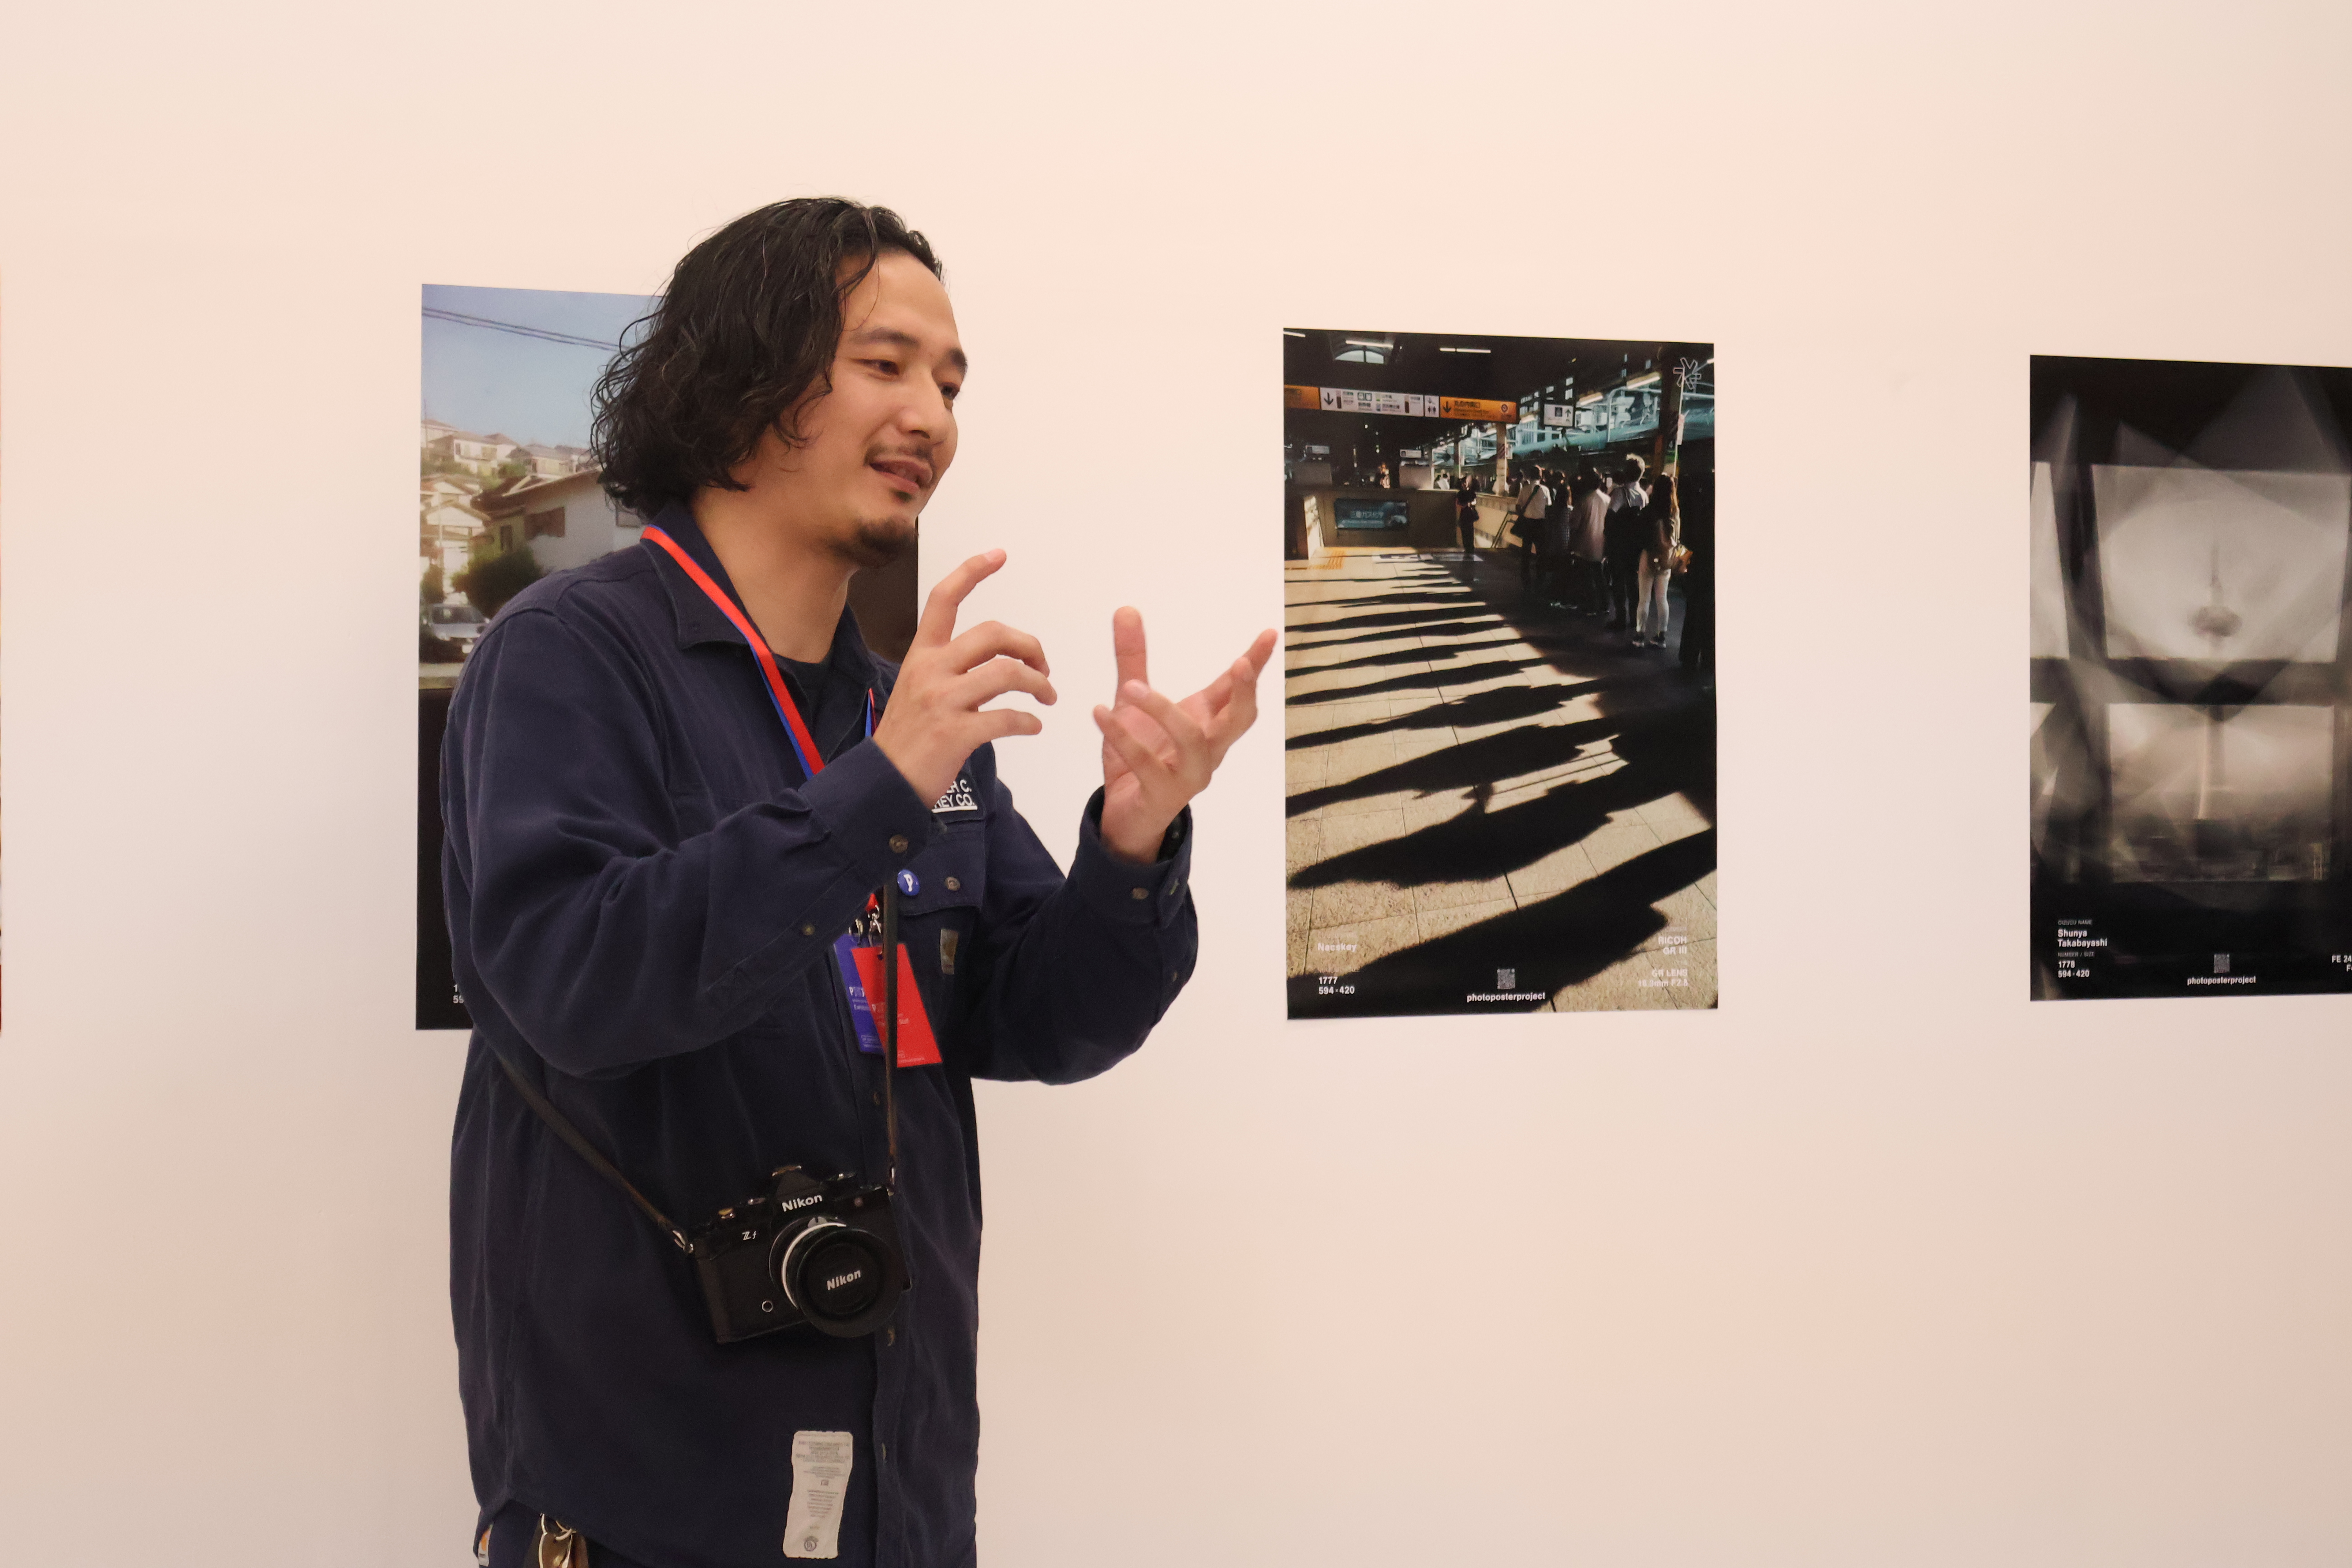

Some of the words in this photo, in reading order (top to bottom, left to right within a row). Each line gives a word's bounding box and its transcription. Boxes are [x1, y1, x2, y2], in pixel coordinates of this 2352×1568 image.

[2058, 929, 2087, 938] Shunya
[1658, 936, 1687, 944] RICOH
[2058, 938, 2107, 948] Takabayashi
[1666, 969, 1688, 977] LENS
[2187, 976, 2256, 986] photoposterproject
[1466, 992, 1546, 1003] photoposterproject
[782, 1194, 822, 1212] Nikon
[827, 1270, 861, 1290] Nikon
